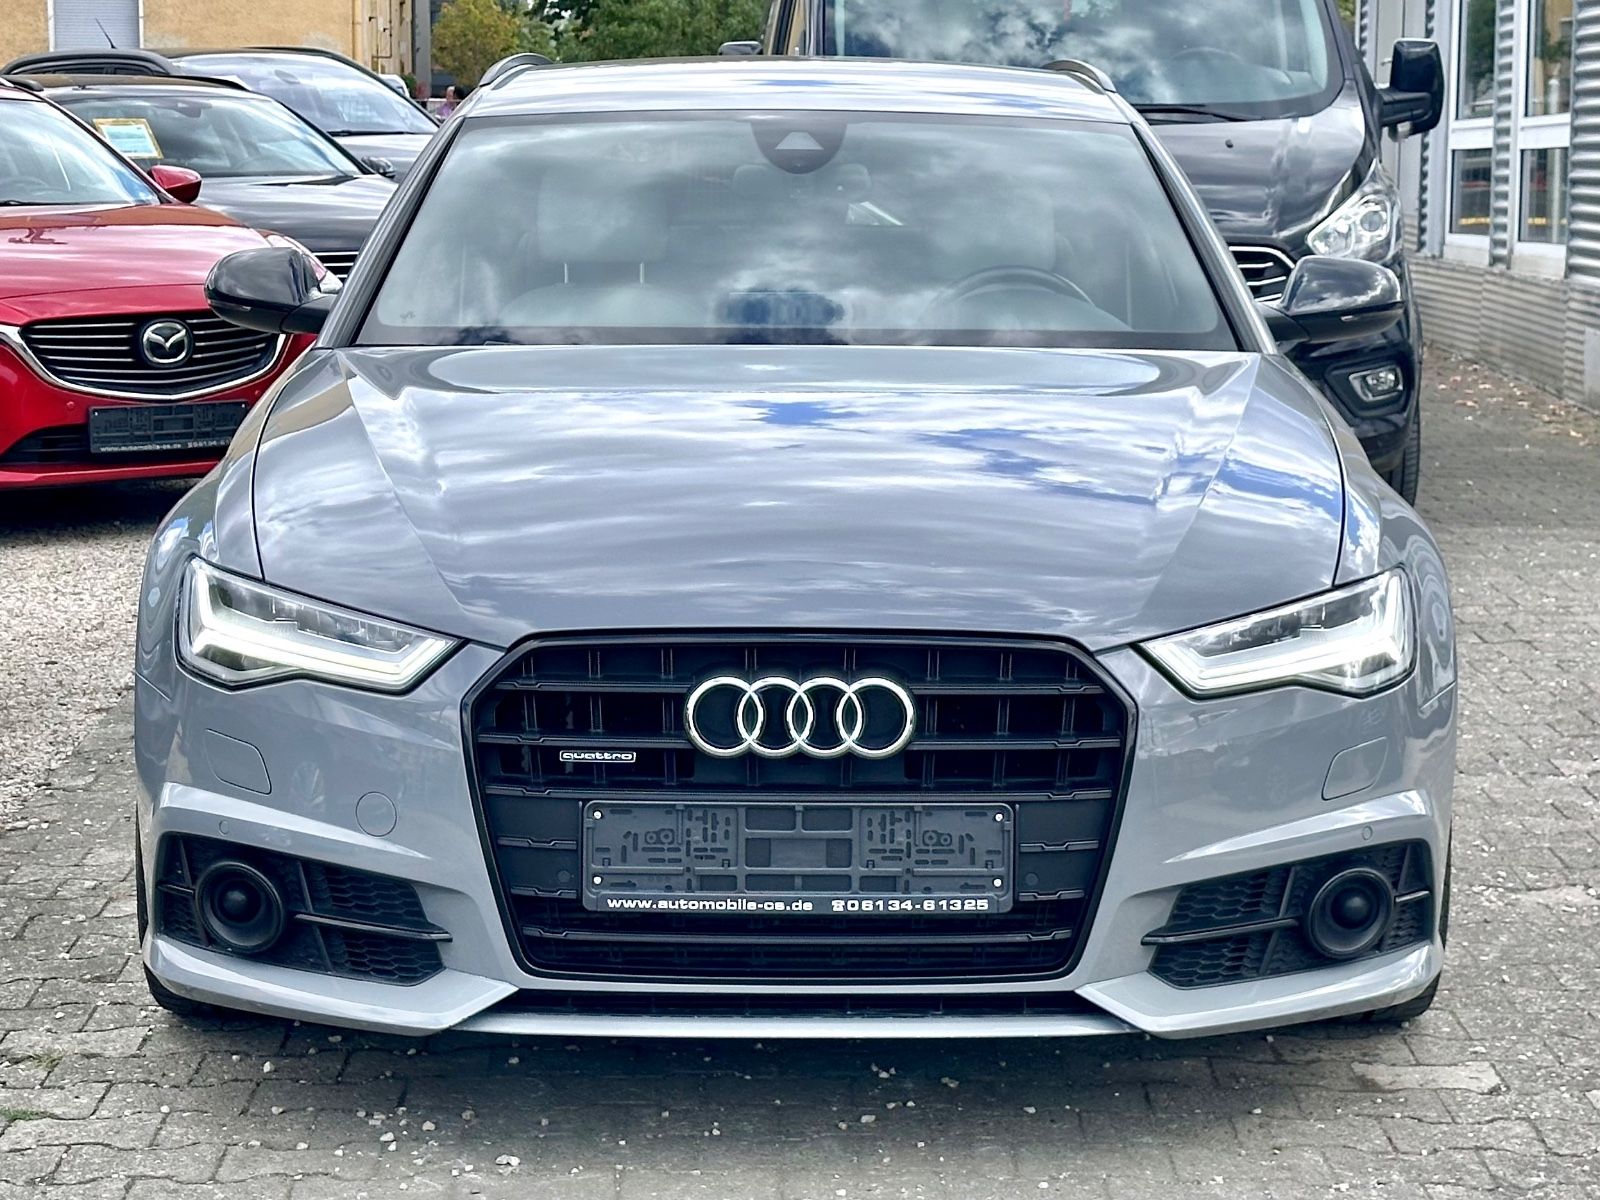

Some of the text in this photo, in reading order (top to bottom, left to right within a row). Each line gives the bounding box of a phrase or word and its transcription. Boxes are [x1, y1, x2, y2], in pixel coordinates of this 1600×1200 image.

[562, 752, 633, 760] quattro
[607, 898, 989, 911] www.automobile-cs.de 06134-61325
